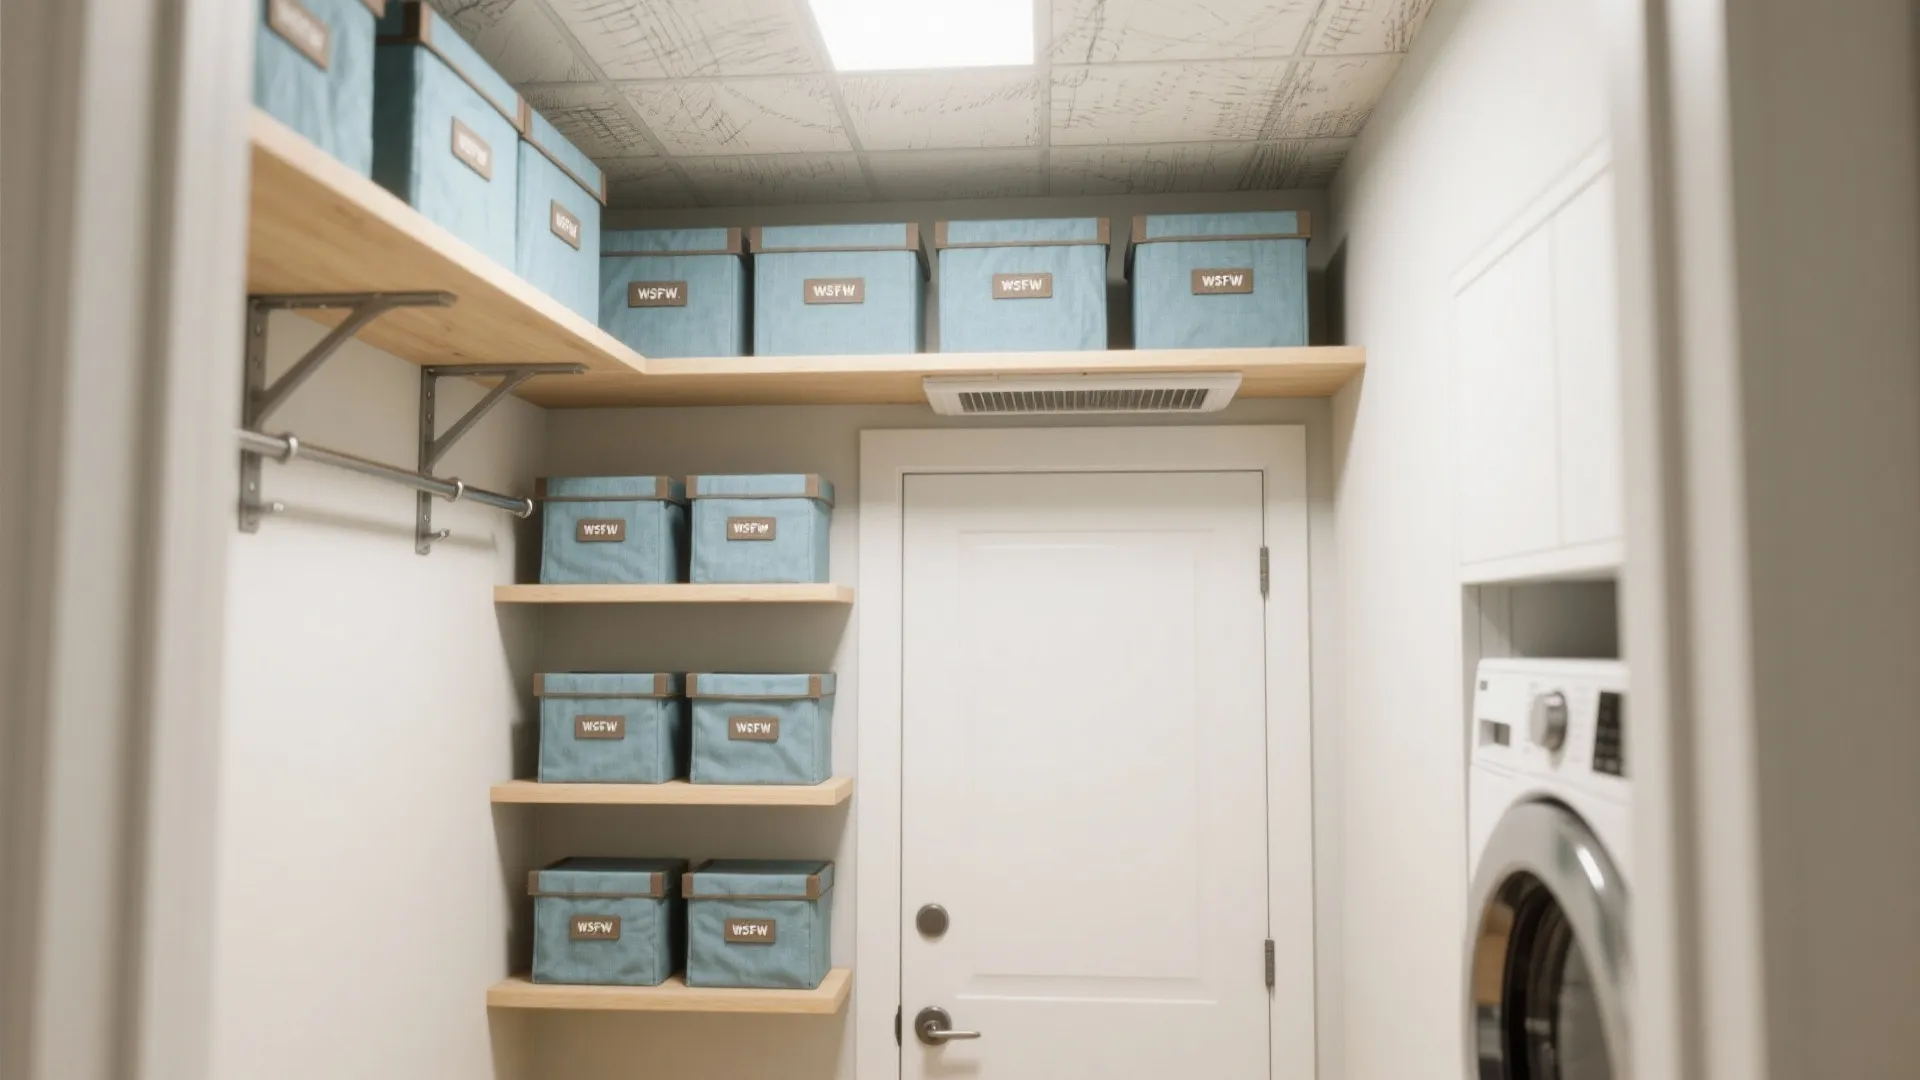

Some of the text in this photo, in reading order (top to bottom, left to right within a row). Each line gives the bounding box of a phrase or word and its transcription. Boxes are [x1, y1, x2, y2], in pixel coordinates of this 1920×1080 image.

[1001, 279, 1042, 292] WSFW
[1201, 274, 1243, 287] WSFW
[638, 287, 678, 300] WSFW
[814, 284, 855, 297] WSFW
